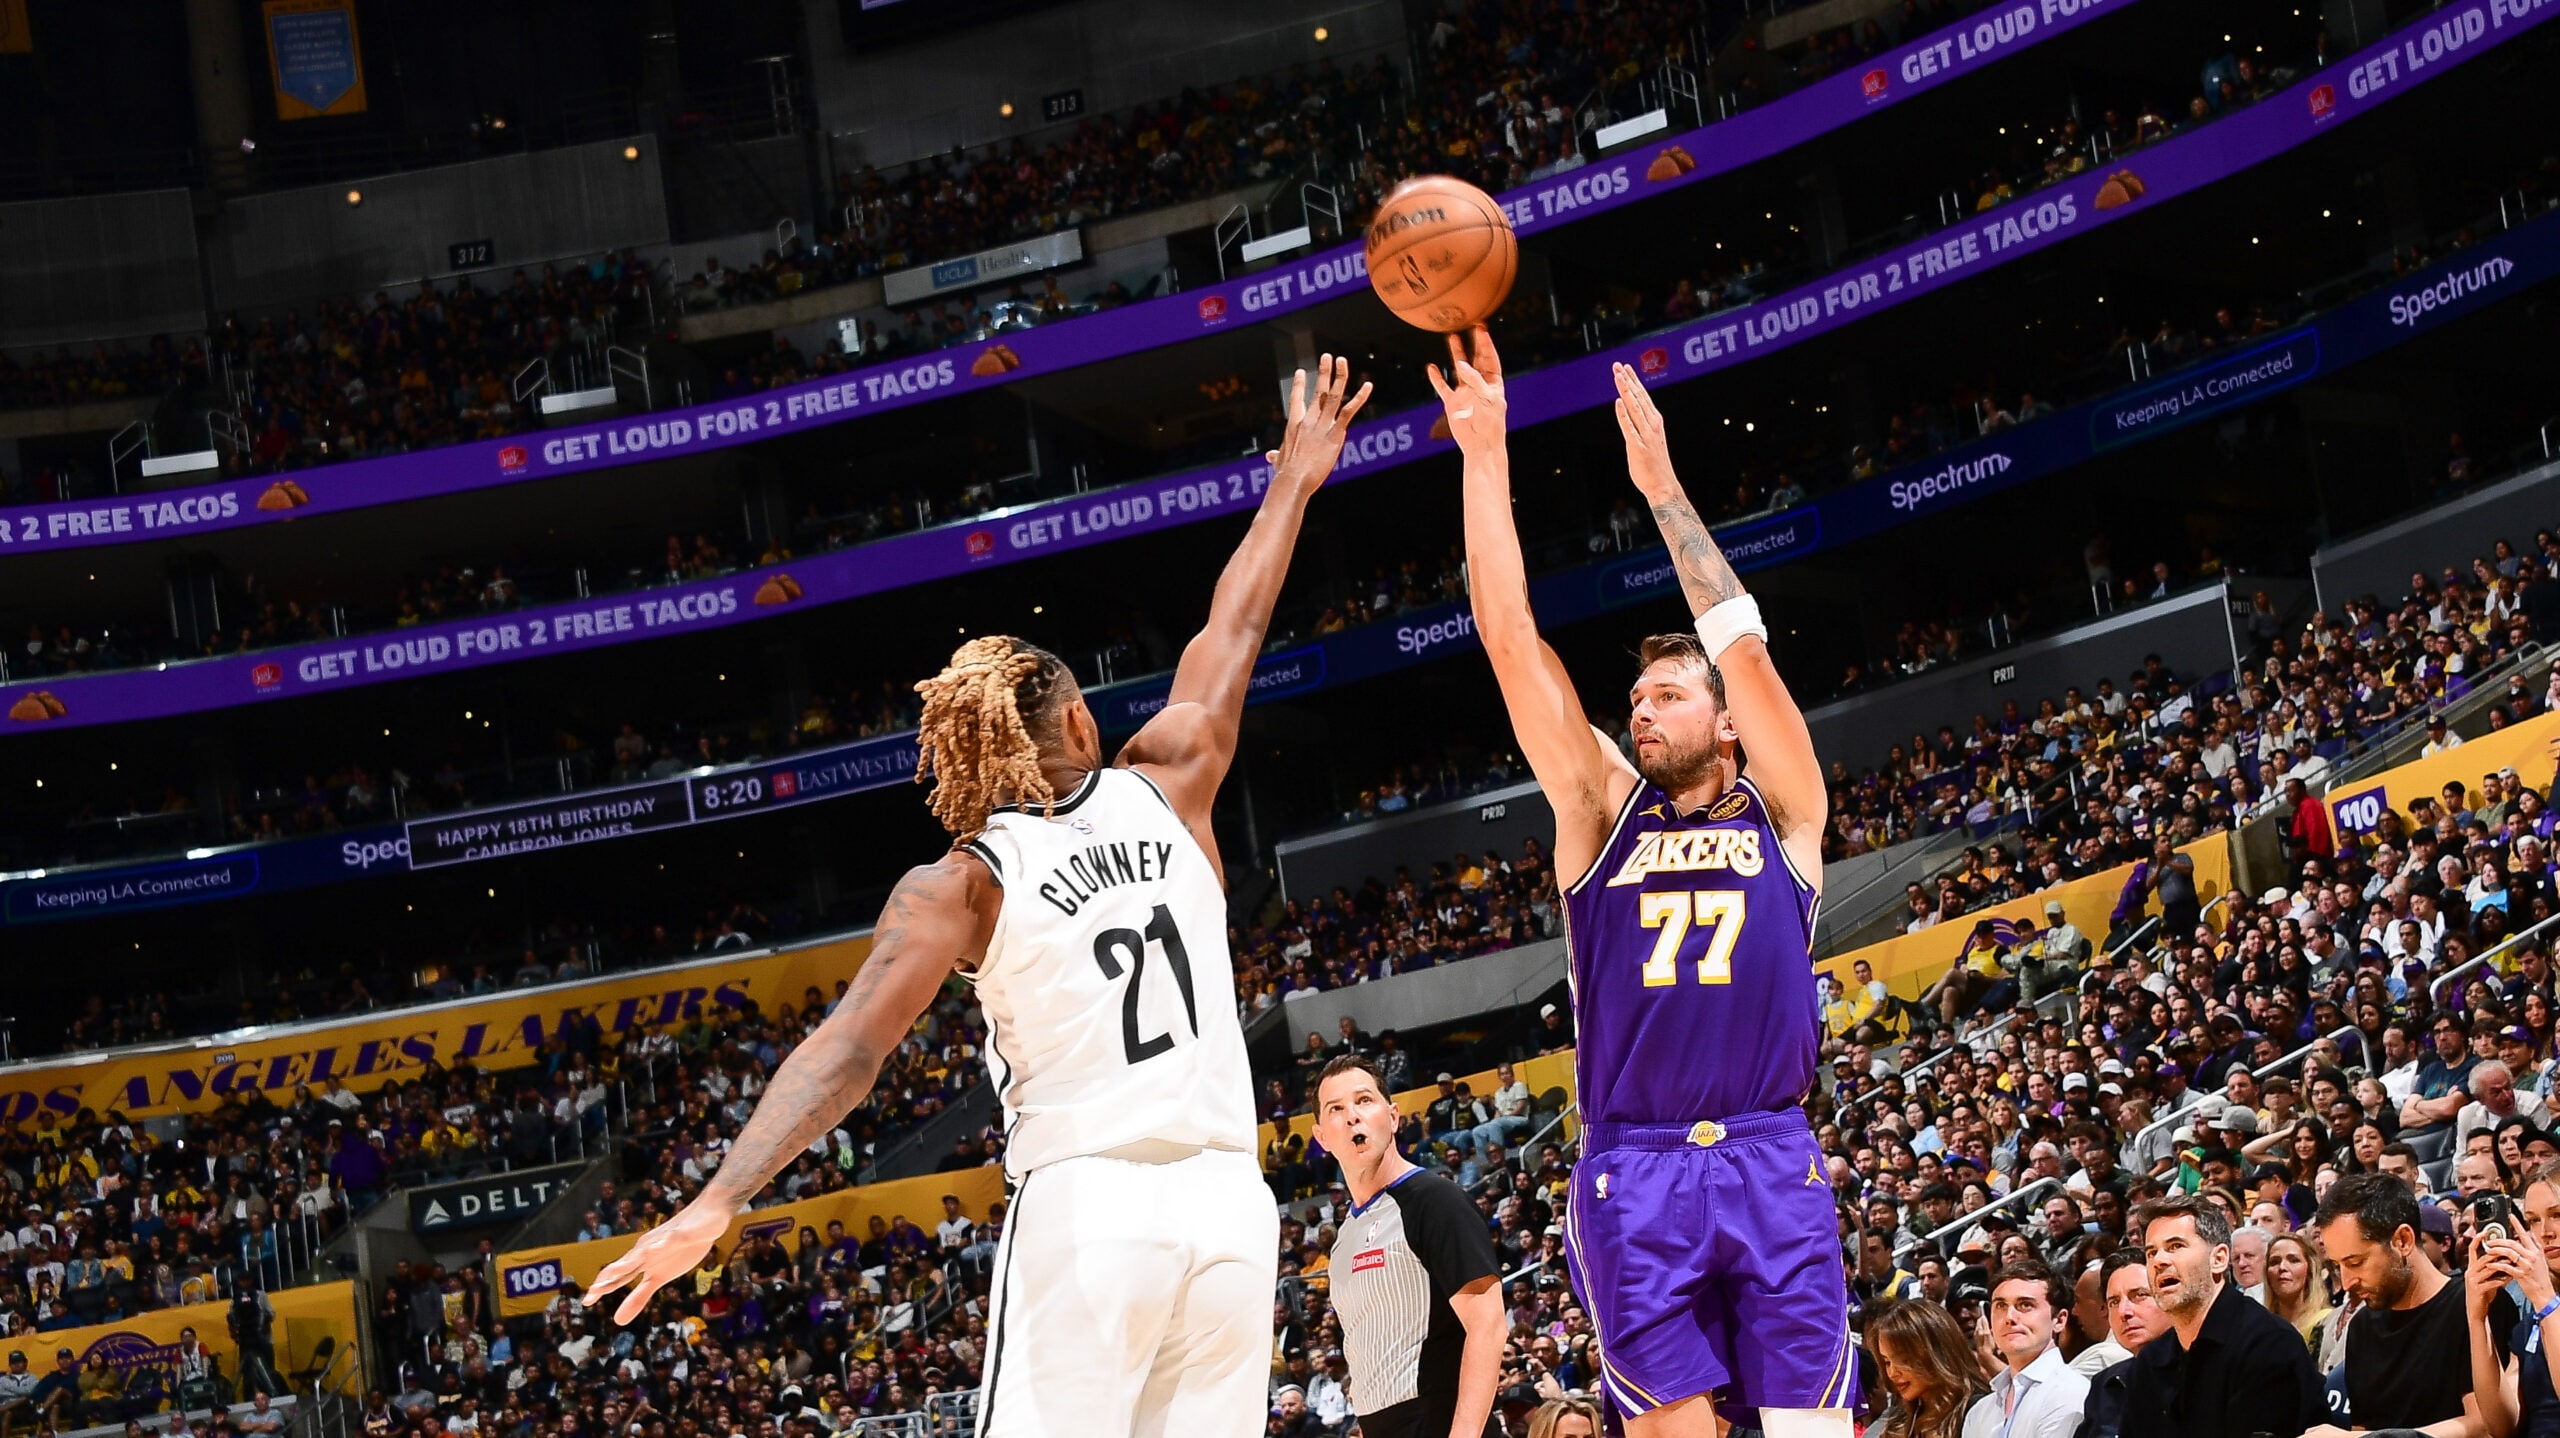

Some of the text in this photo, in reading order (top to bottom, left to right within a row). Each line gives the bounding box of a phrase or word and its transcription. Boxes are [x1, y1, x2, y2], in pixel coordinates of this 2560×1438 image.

[1902, 40, 1952, 83] GET
[1958, 7, 2036, 60] LOUD
[2349, 49, 2399, 98] GET
[2406, 9, 2485, 70] LOUD
[1500, 167, 1630, 229] EE TACOS
[457, 246, 487, 265] 312
[937, 250, 1033, 284] UCLA Health
[1242, 276, 1293, 312] GET
[1684, 325, 1738, 364] GET
[1745, 298, 1819, 346] LOUD
[1824, 274, 1881, 316] FOR
[1886, 264, 1903, 293] 2
[1908, 233, 1980, 284] FREE
[1984, 195, 2077, 253] TACOS
[2389, 257, 2507, 327] Spectrum
[2115, 350, 2293, 430] Keeping LA Connected
[544, 360, 955, 465] GET LOUD FOR 2 FREE TACOS
[1333, 425, 1413, 469] ACOS
[1890, 453, 2006, 511] Spectrum
[21, 517, 41, 541] 2
[48, 508, 133, 539] FREE
[138, 493, 239, 529] TACOS
[1009, 515, 1065, 548] GET
[1072, 497, 1153, 536] LOUD
[1160, 482, 1222, 516] FOR
[1227, 475, 1245, 501] 2
[1723, 526, 1796, 561] onnected
[1624, 565, 1676, 589] Keepin
[300, 589, 737, 682] GET LOUD FOR 2 FREE TACOS
[1397, 613, 1473, 655] Spectr
[1251, 663, 1302, 688] nected
[1992, 665, 2016, 685] PR11
[1128, 699, 1167, 716] Keep
[895, 749, 919, 770] BA
[704, 777, 762, 808] 8:20
[1481, 804, 1506, 821] PR10
[1711, 795, 1746, 819] bibigo
[2339, 795, 2380, 831] 110
[437, 797, 656, 848] HAPPY 18TH BIRTHDAY
[342, 837, 410, 869] Spec
[1605, 828, 1766, 888] LAKERS
[36, 867, 231, 907] Keeping LA Connected
[1039, 840, 1173, 917] CLOWNEY
[1639, 890, 1747, 989] 77
[1093, 903, 1199, 1065] 21
[0, 979, 751, 1126] OS ANGELES LAKERS
[511, 1264, 558, 1292] 108
[1352, 1253, 1384, 1270] Emirates
